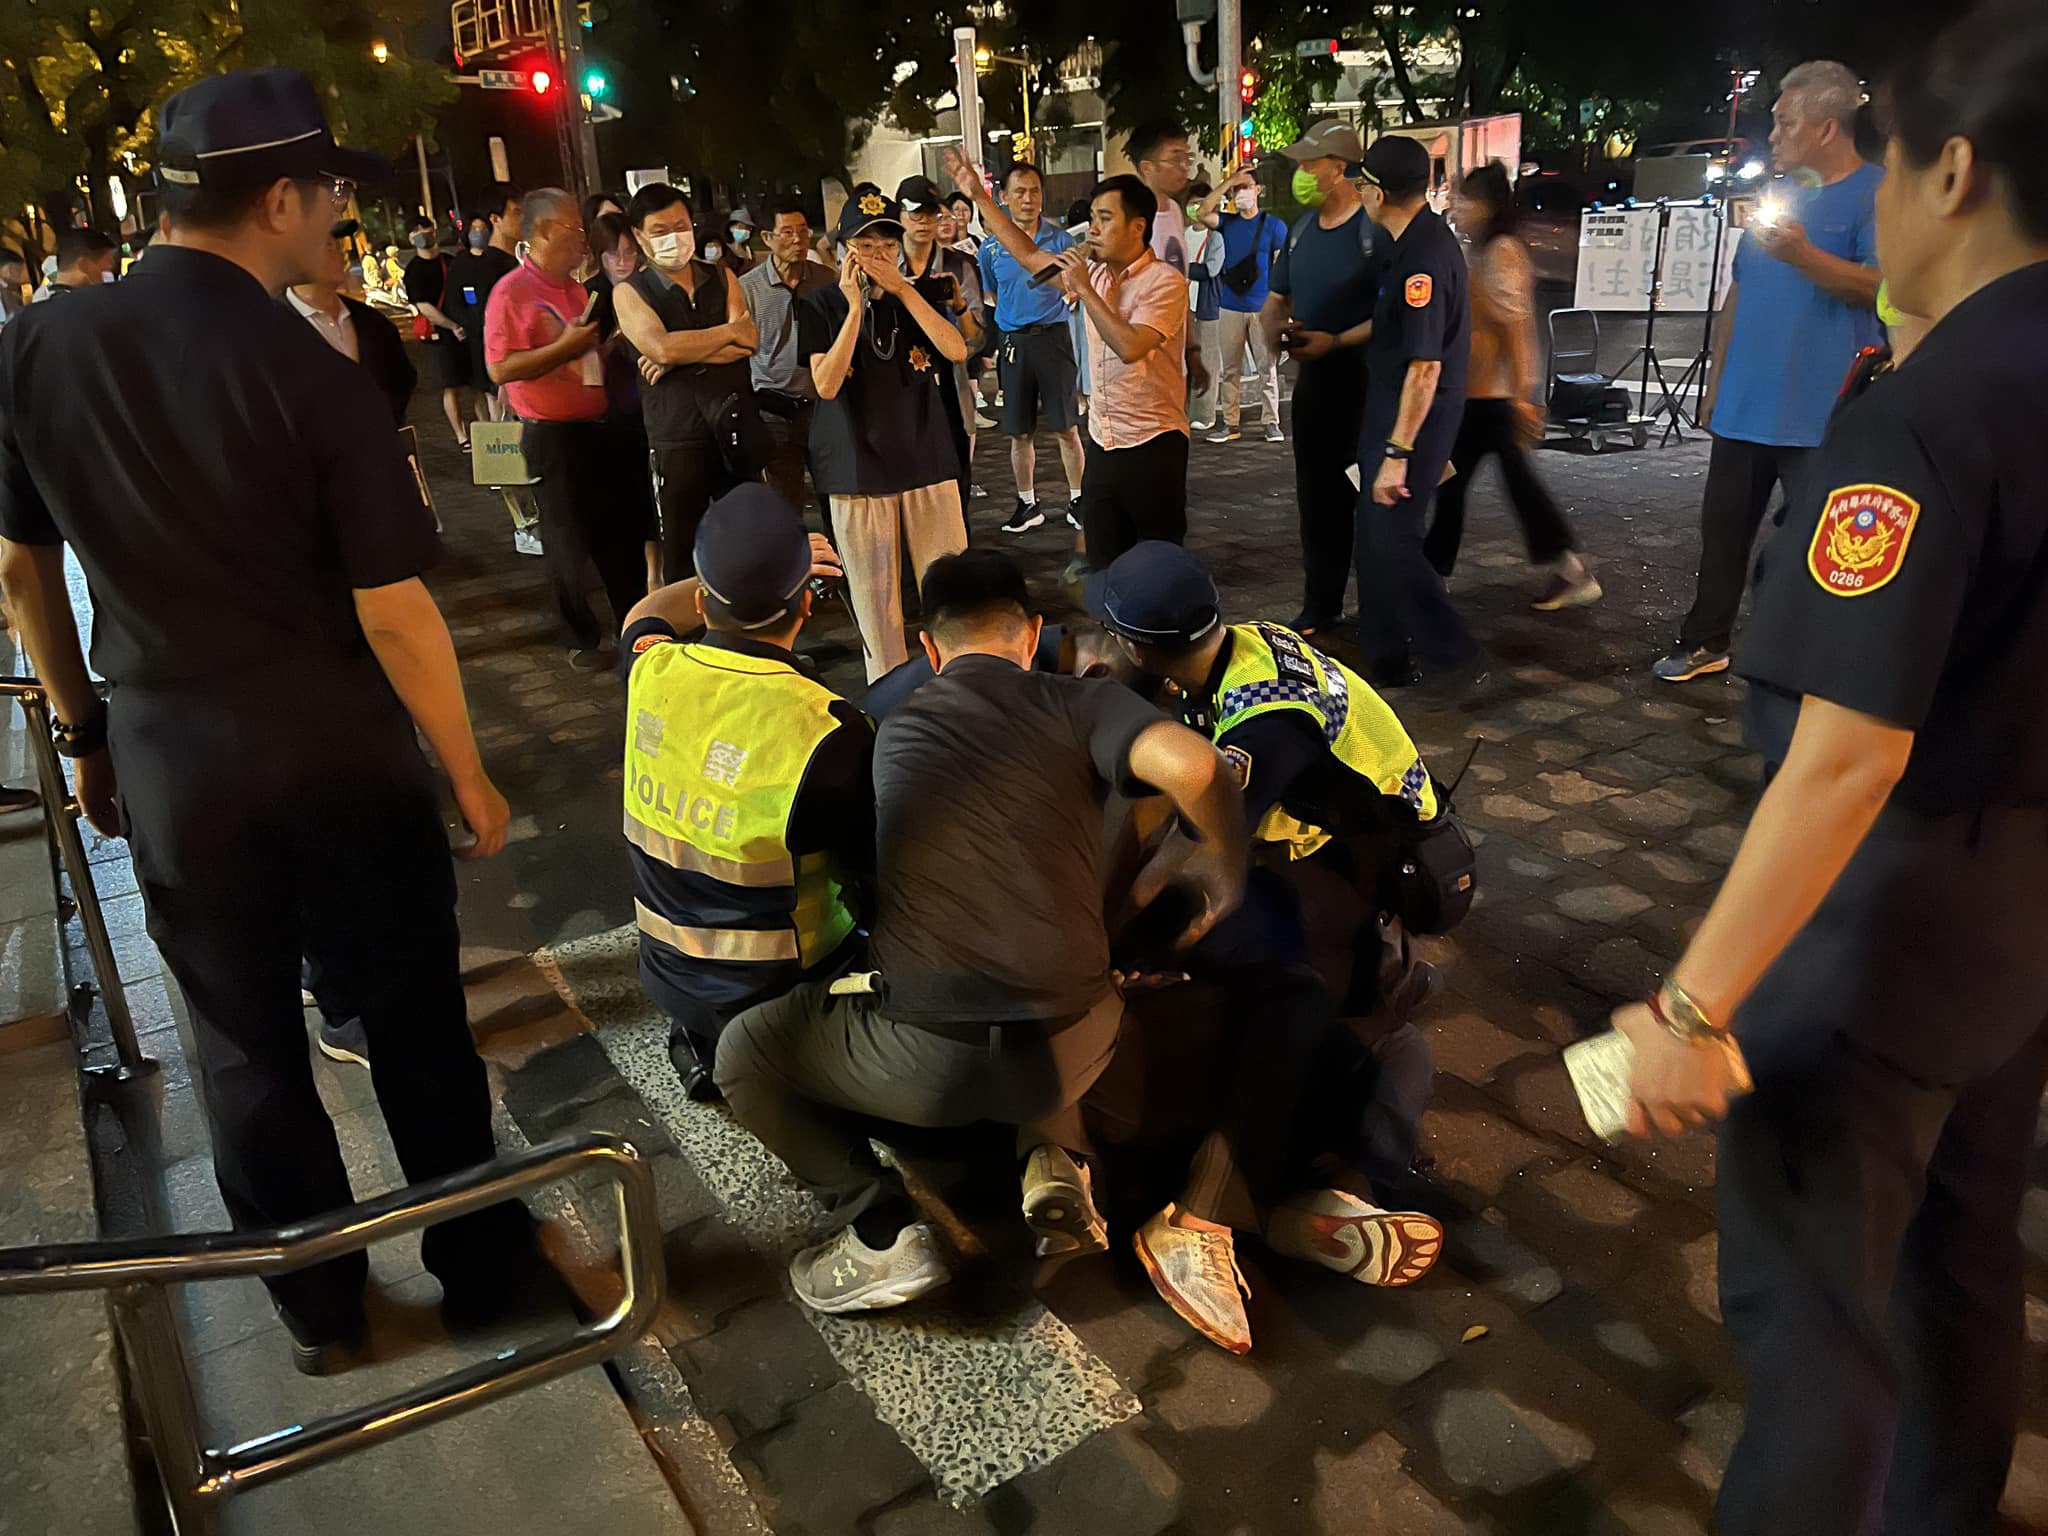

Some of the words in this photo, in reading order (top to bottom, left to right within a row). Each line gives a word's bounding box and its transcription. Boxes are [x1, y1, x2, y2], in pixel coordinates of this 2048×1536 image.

[486, 441, 519, 455] MIPR
[1829, 570, 1865, 588] 0286
[630, 763, 737, 841] POLICE
